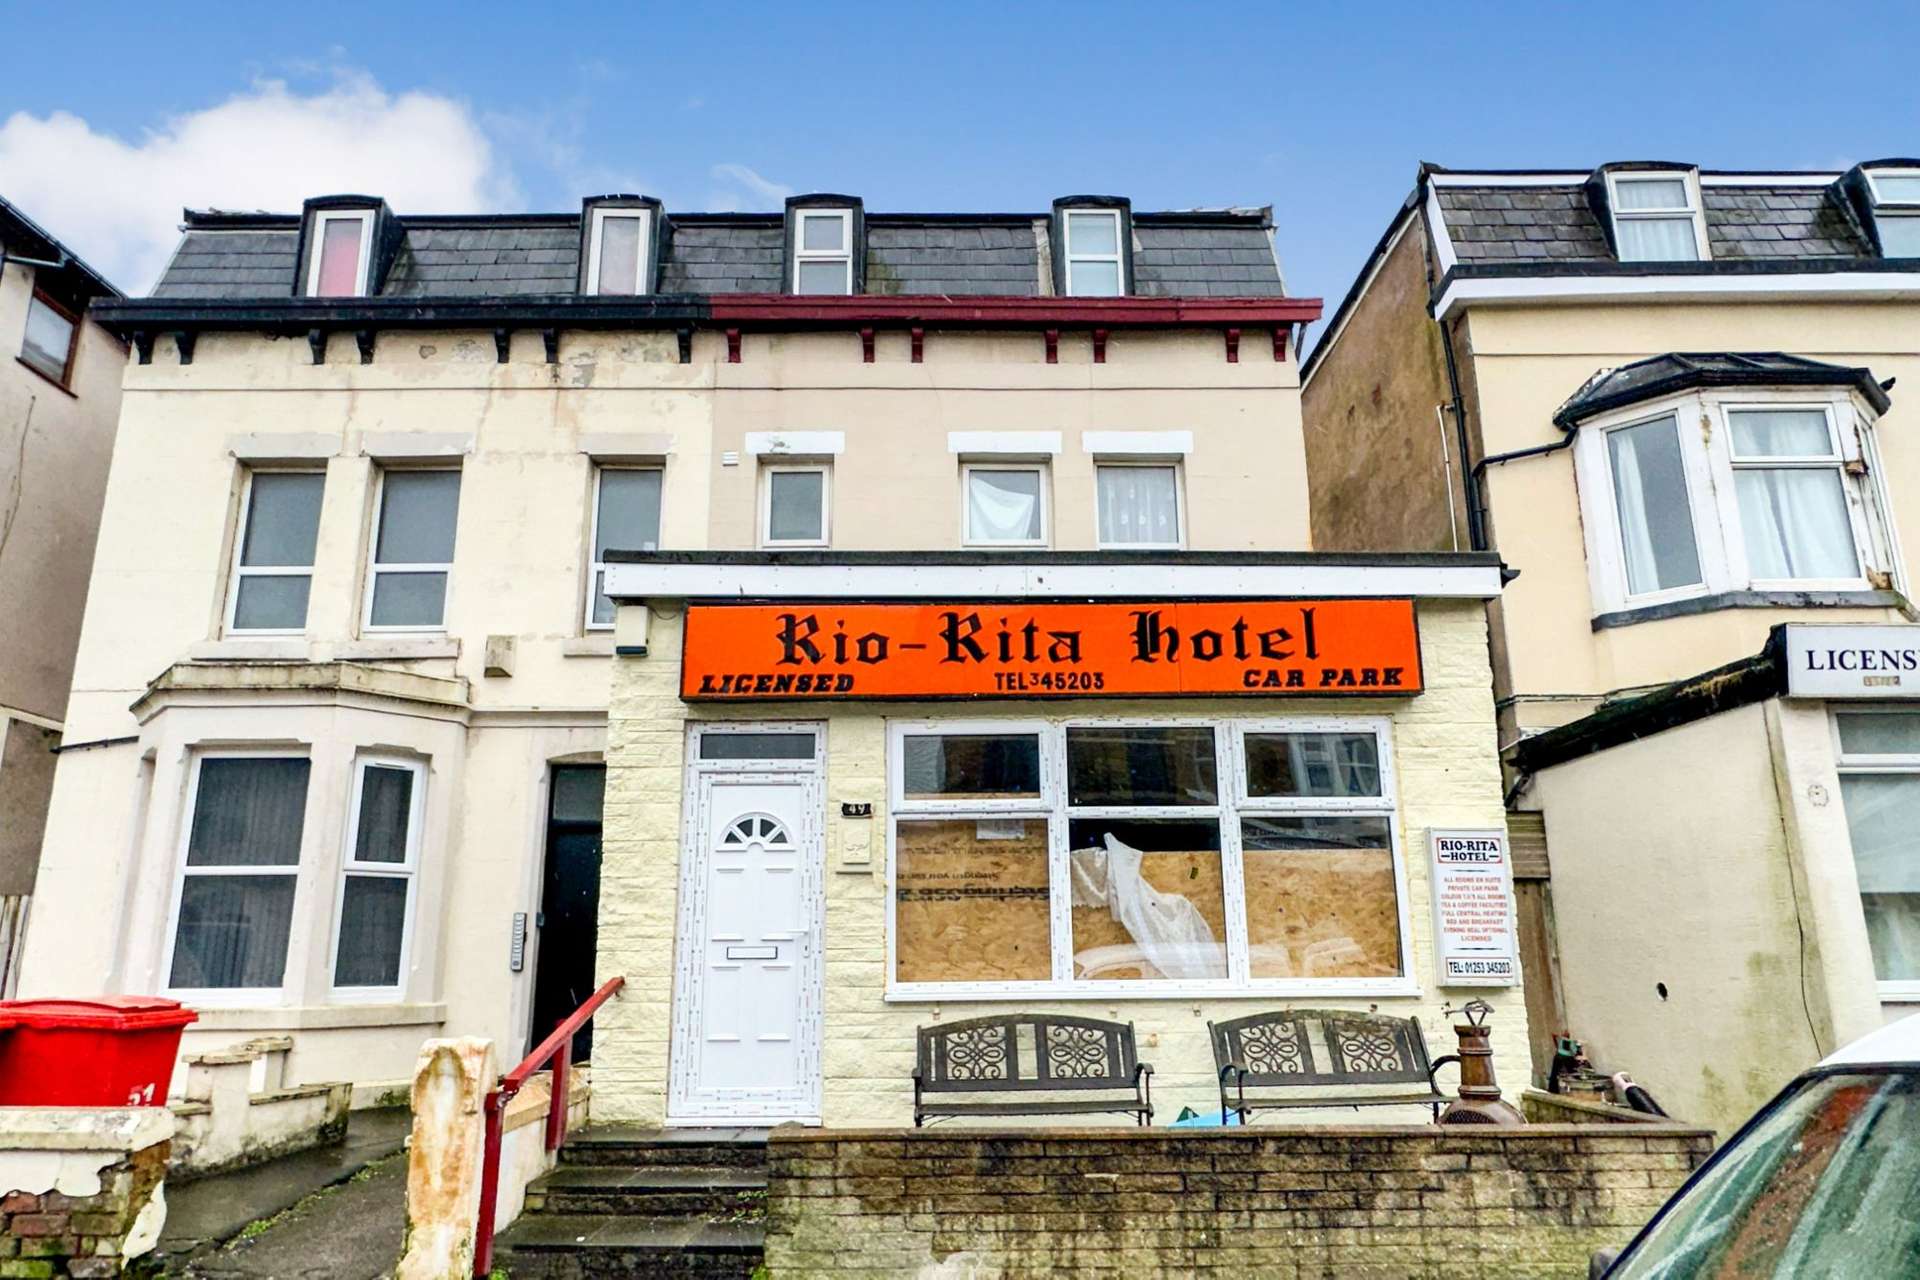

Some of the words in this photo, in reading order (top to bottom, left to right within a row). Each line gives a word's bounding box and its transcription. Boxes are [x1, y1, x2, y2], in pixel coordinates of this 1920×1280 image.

[1805, 649, 1920, 670] LICENS
[1243, 669, 1305, 687] CAR
[1319, 667, 1404, 687] PARK
[699, 674, 854, 693] LICENSED
[848, 803, 866, 814] 49
[1440, 840, 1498, 851] RIO-RITA
[1450, 852, 1489, 861] HOTEL
[1449, 961, 1464, 973] TEL:
[1465, 961, 1486, 973] 01253
